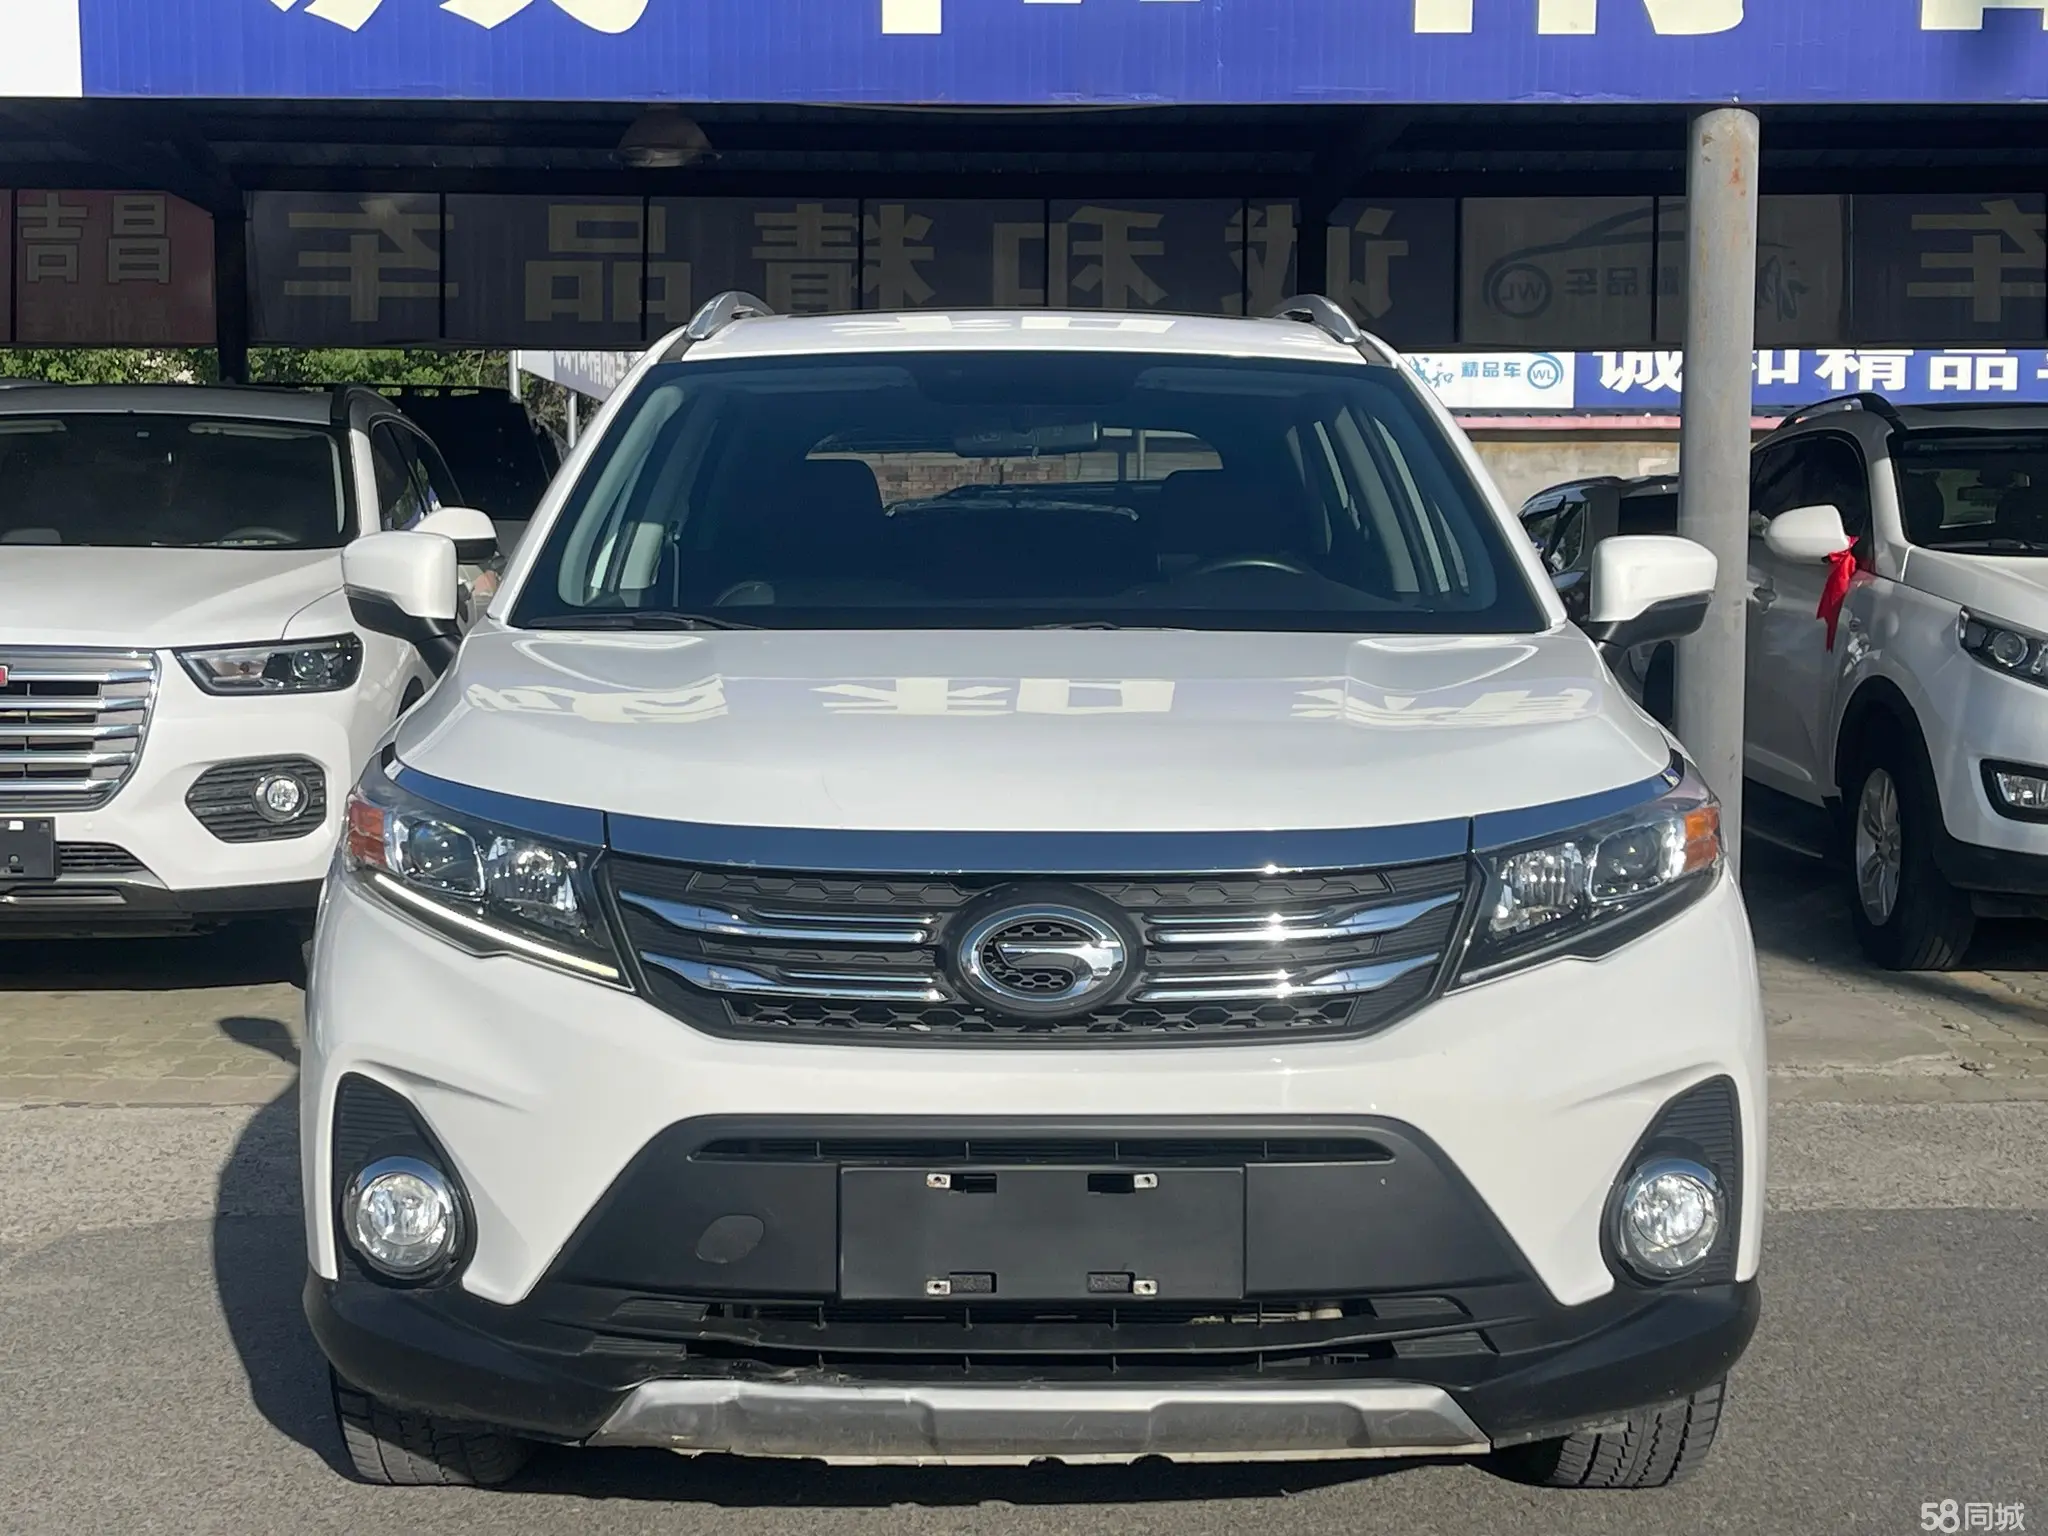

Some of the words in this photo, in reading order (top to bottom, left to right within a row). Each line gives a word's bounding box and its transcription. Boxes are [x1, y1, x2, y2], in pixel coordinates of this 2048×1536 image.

[1461, 361, 1521, 378] 精品车
[1533, 369, 1553, 380] WL
